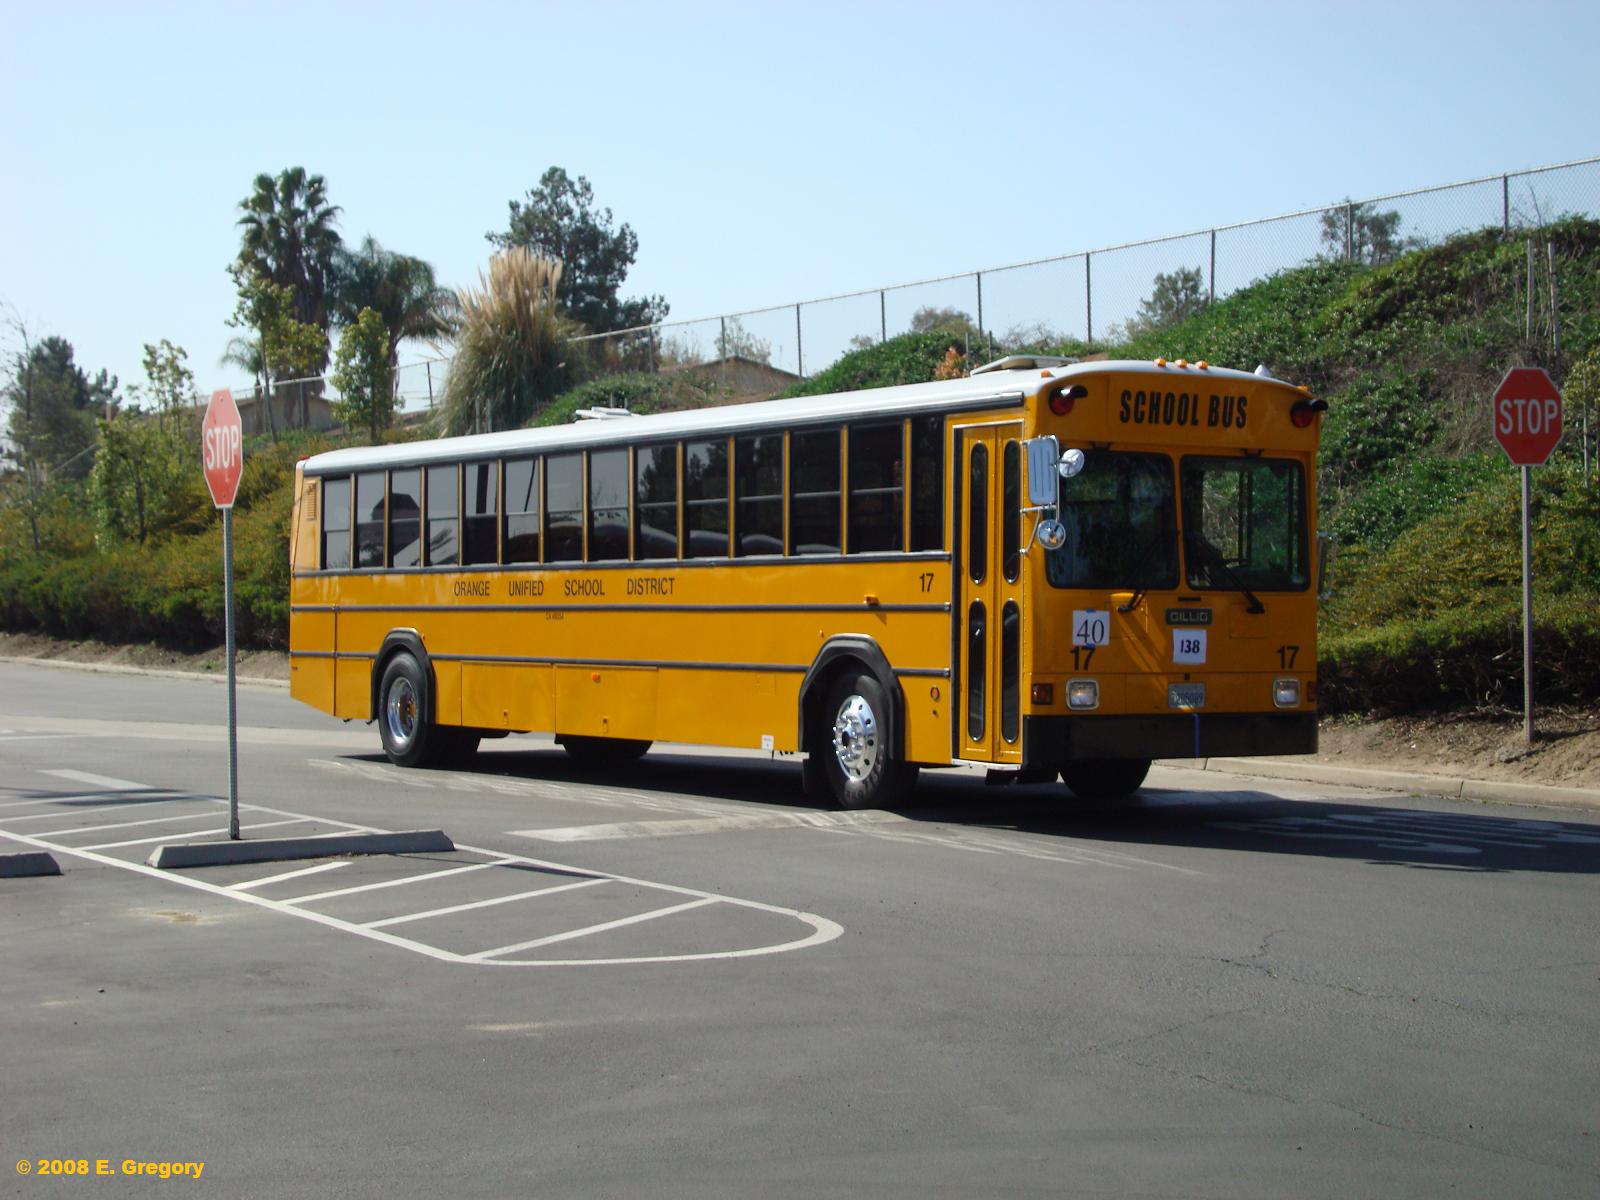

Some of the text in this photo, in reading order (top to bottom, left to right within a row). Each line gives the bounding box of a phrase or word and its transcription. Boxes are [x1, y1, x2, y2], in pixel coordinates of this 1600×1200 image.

[1120, 389, 1248, 428] SCHOOL BUS
[1500, 399, 1558, 434] STOP
[206, 425, 239, 471] STOP
[454, 577, 675, 597] ORANGE UNIFIED SCHOOL DISTRICT
[919, 573, 934, 592] 17
[1170, 611, 1208, 622] GILLIG
[1076, 619, 1104, 644] 40
[1070, 646, 1096, 671] 17
[1180, 639, 1200, 654] 138
[1277, 645, 1299, 669] 17
